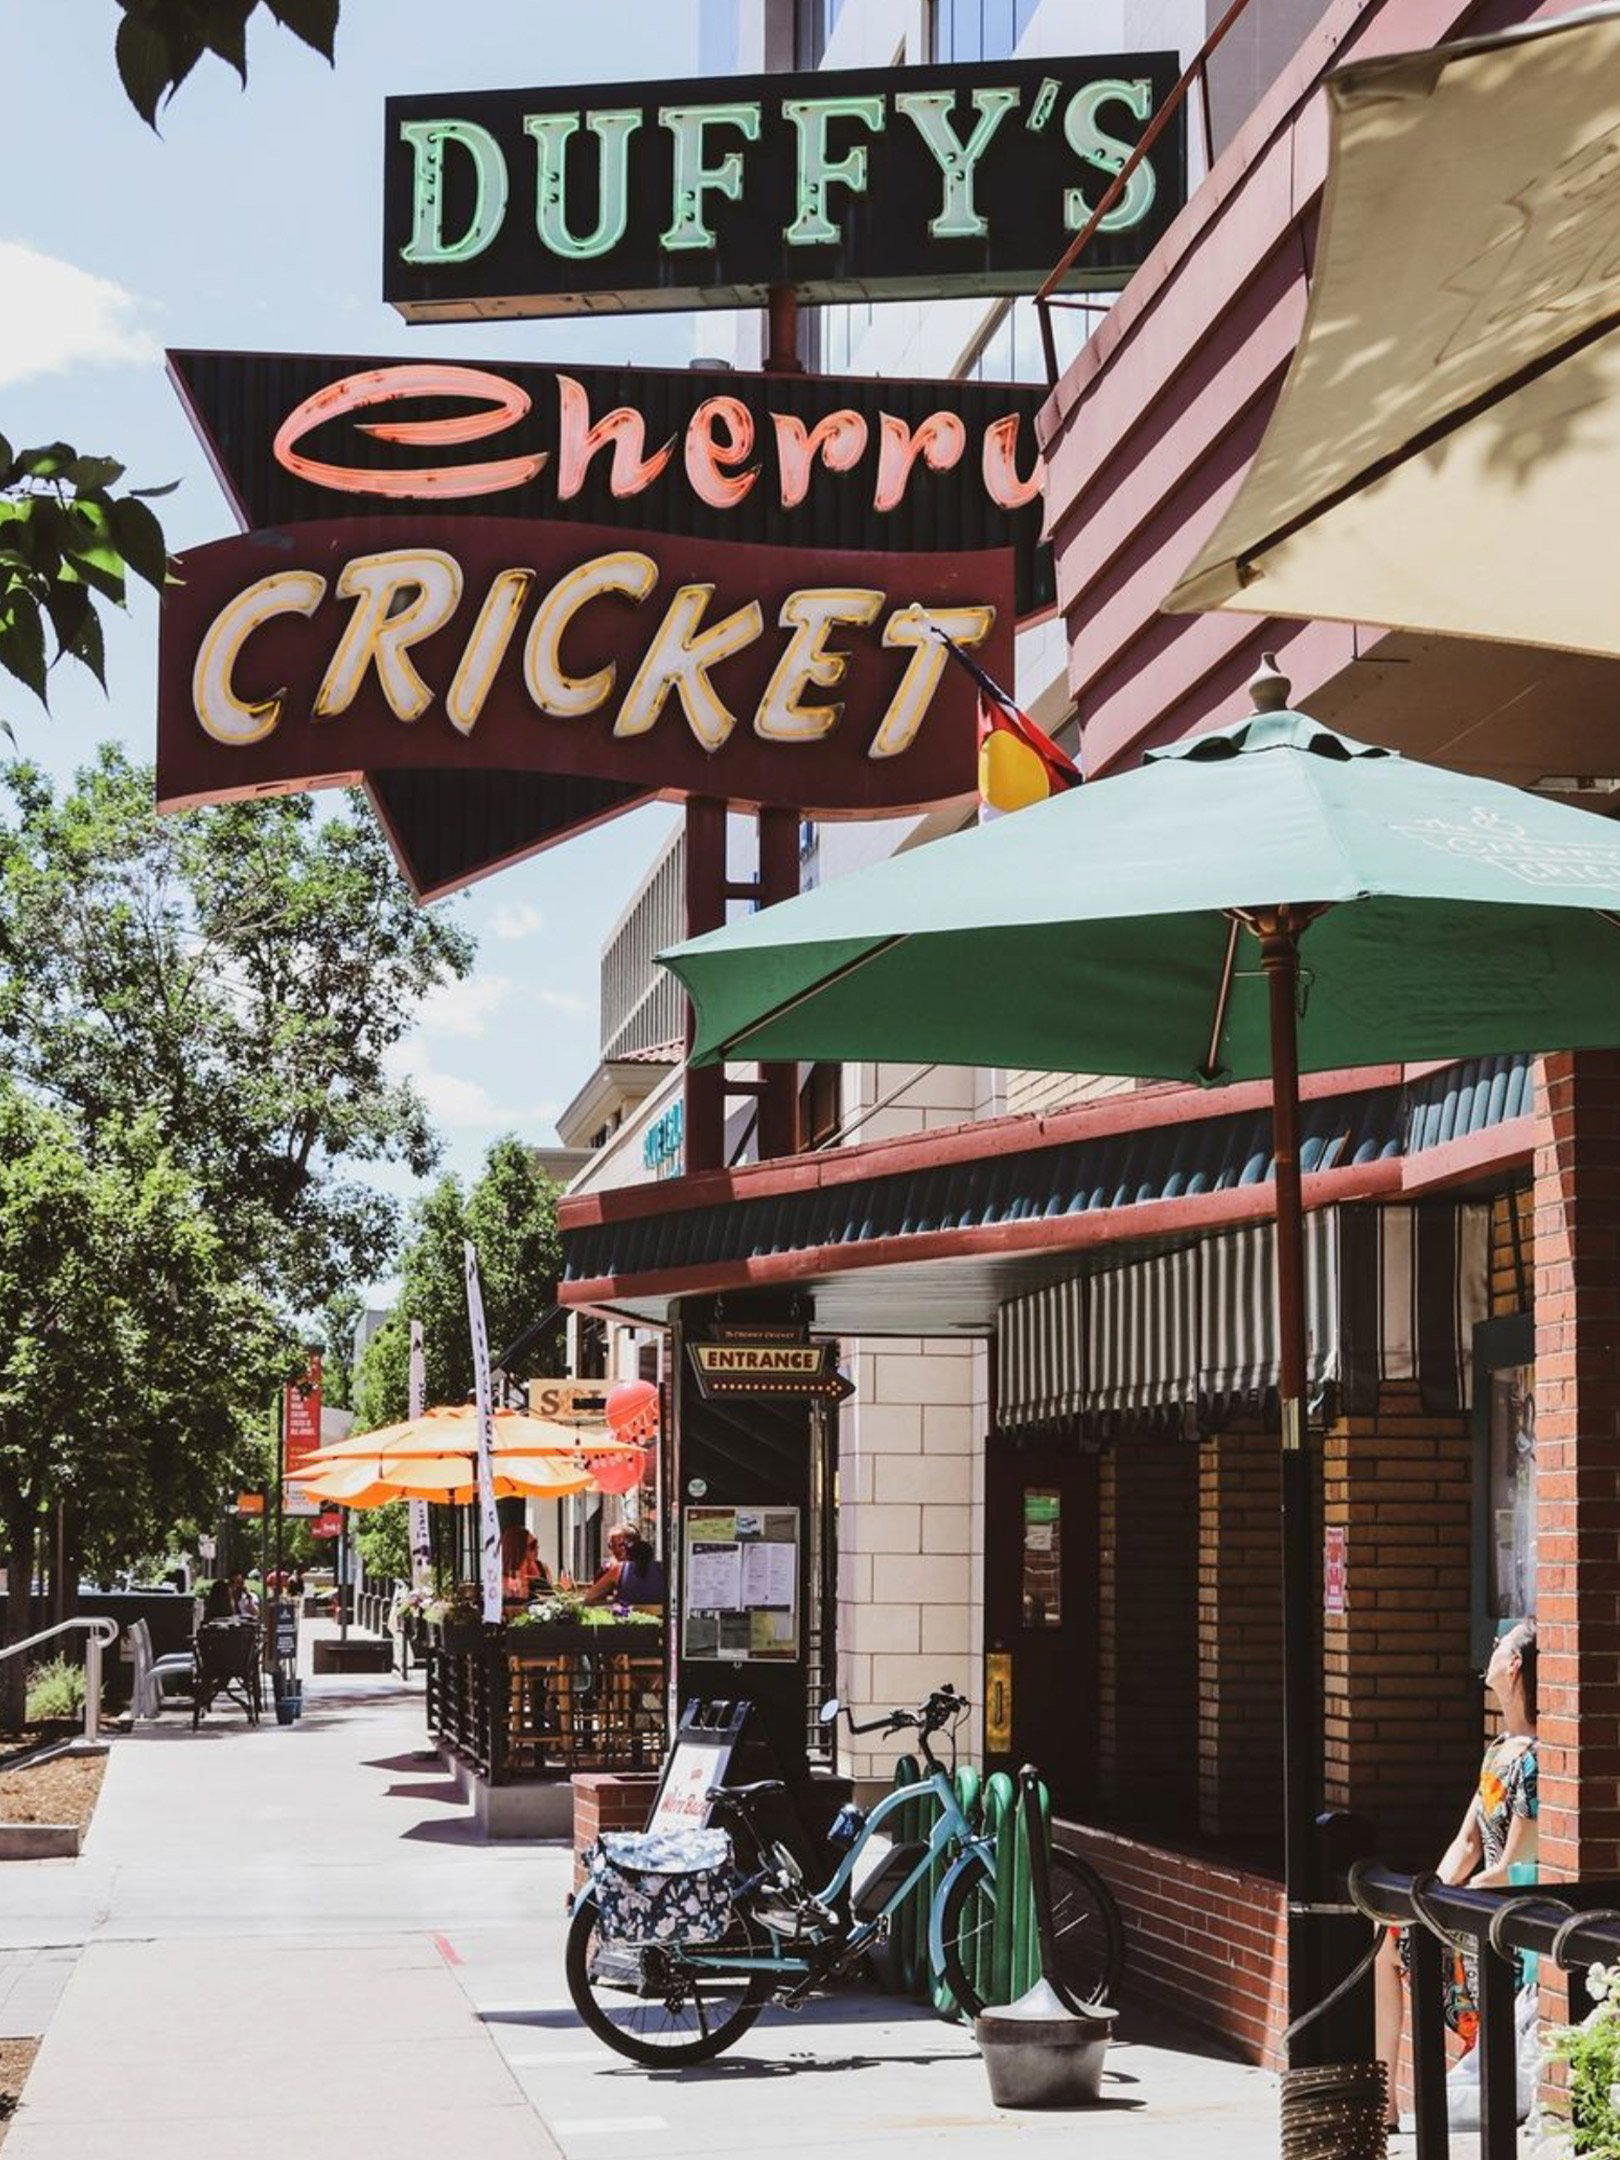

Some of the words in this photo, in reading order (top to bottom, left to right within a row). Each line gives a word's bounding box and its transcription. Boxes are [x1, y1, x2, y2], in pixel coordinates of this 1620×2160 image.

[400, 78, 1157, 264] DUFFY'S
[191, 548, 996, 759] CRICKET
[708, 1351, 813, 1369] ENTRANCE
